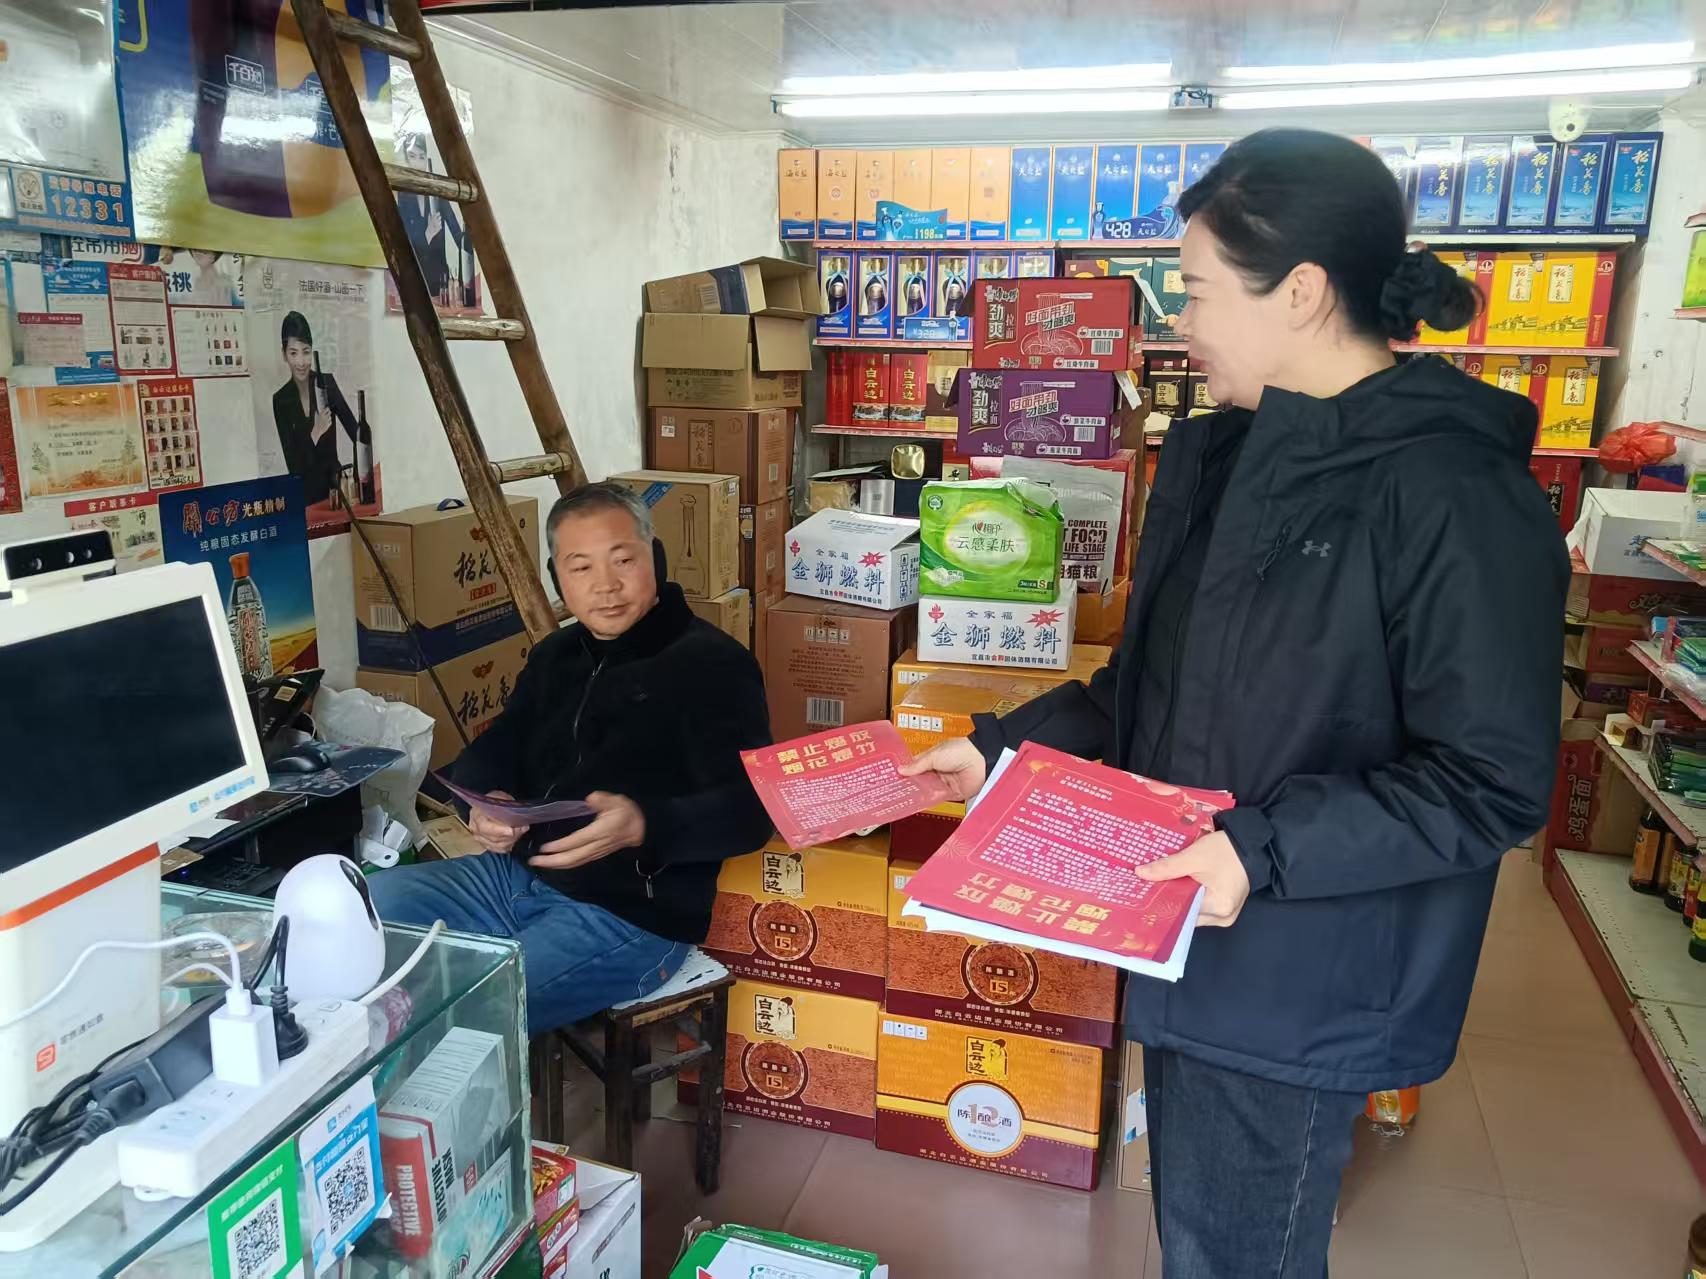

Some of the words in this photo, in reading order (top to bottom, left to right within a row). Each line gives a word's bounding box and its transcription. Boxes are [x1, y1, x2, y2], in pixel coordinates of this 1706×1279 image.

[51, 194, 124, 222] 12331
[919, 228, 935, 240] 198
[1105, 223, 1132, 239] 428
[988, 304, 1005, 339] 劲爽
[1026, 302, 1075, 326] 好面带劲
[1044, 313, 1077, 331] 才够爽
[972, 390, 988, 424] 劲爽
[1010, 390, 1058, 412] 好面带劲
[1027, 401, 1059, 418] 才够爽
[1067, 519, 1108, 529] COMPLETE
[1071, 529, 1108, 543] FOOD
[956, 535, 1016, 553] 云感柔肤
[1064, 542, 1080, 553] LIFE
[1082, 543, 1106, 554] STAGE
[791, 556, 886, 598] 金狮燃料
[966, 609, 1013, 620] 全家福
[930, 622, 1062, 655] 金狮燃料
[777, 730, 873, 764] 禁止燃放
[781, 741, 878, 776] 烟花爆竹
[765, 854, 782, 893] 白云边
[952, 882, 1101, 936] 禁止燃放
[968, 871, 1113, 922] 烟花爆竹
[775, 936, 791, 951] 15
[990, 980, 1008, 994] 15
[757, 997, 775, 1033] 白云边
[968, 1039, 987, 1075] 白云边
[441, 1146, 456, 1190] MASK
[395, 1163, 423, 1237] PROTECTIVE
